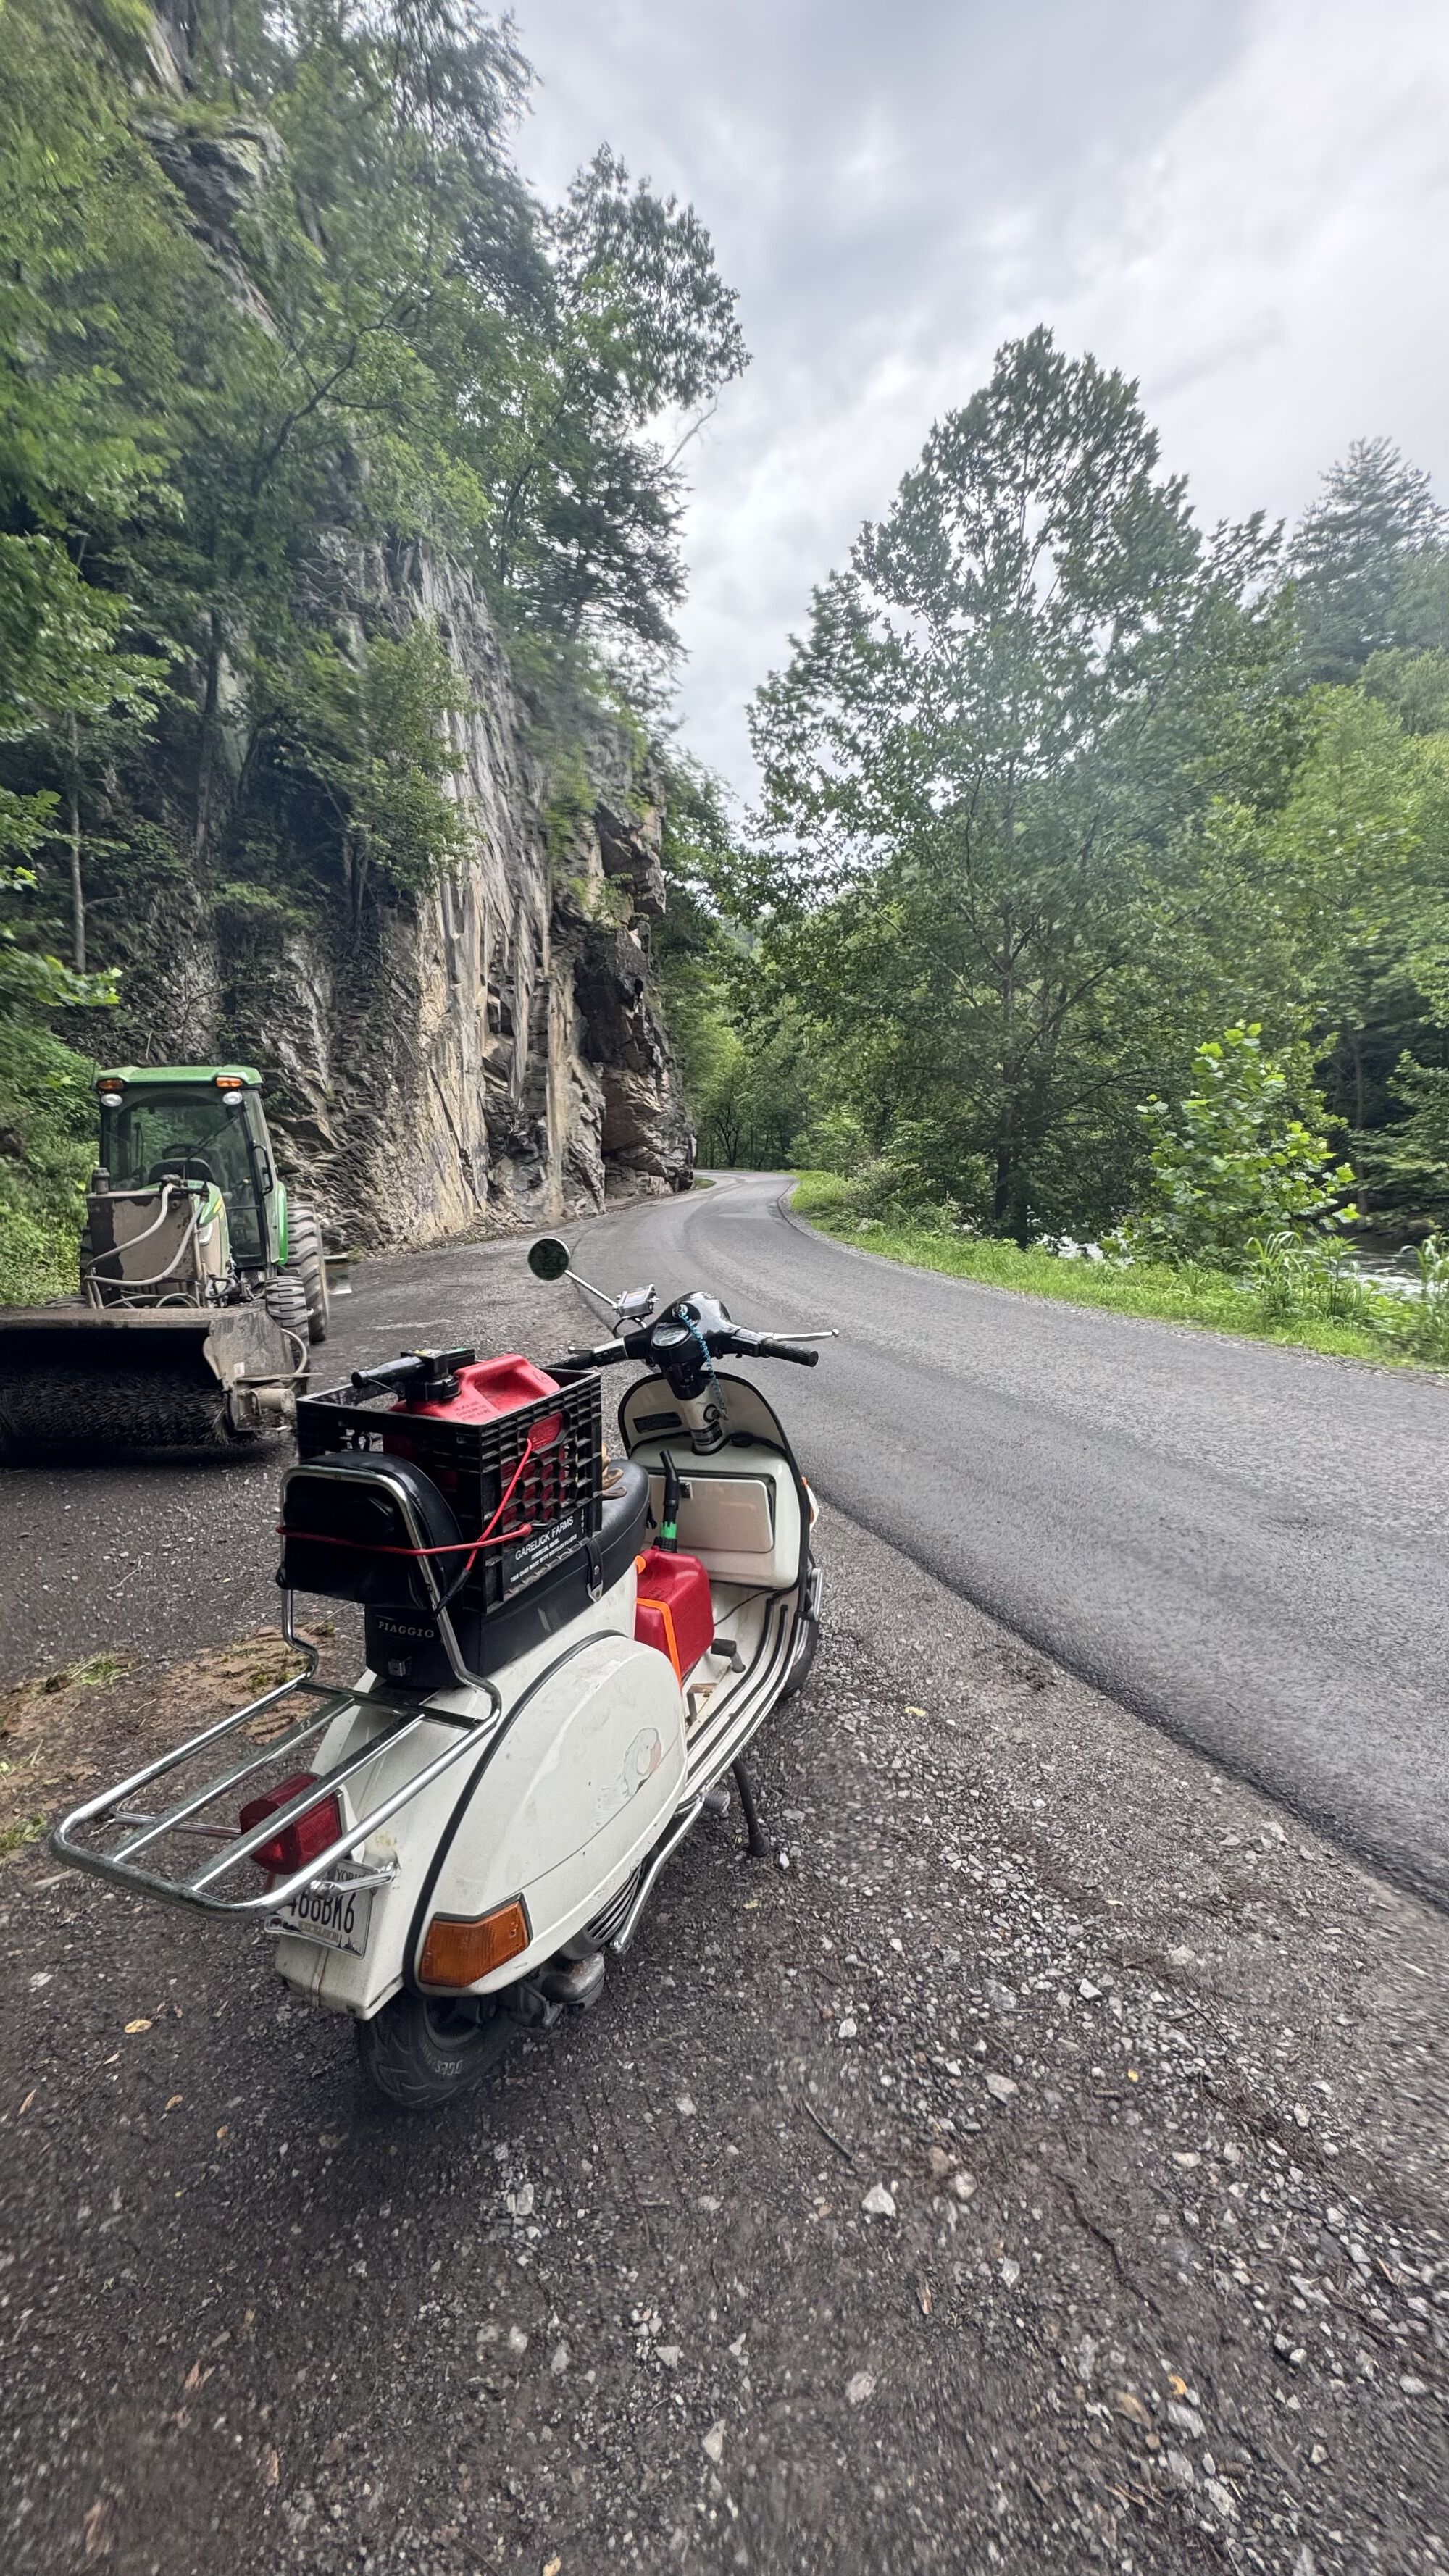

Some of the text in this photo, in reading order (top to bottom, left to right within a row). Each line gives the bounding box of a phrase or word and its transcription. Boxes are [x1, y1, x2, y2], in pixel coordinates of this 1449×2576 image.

[515, 1532, 551, 1560] GARELICK
[551, 1515, 574, 1538] FARMS
[378, 1621, 435, 1639] PIAGGIO
